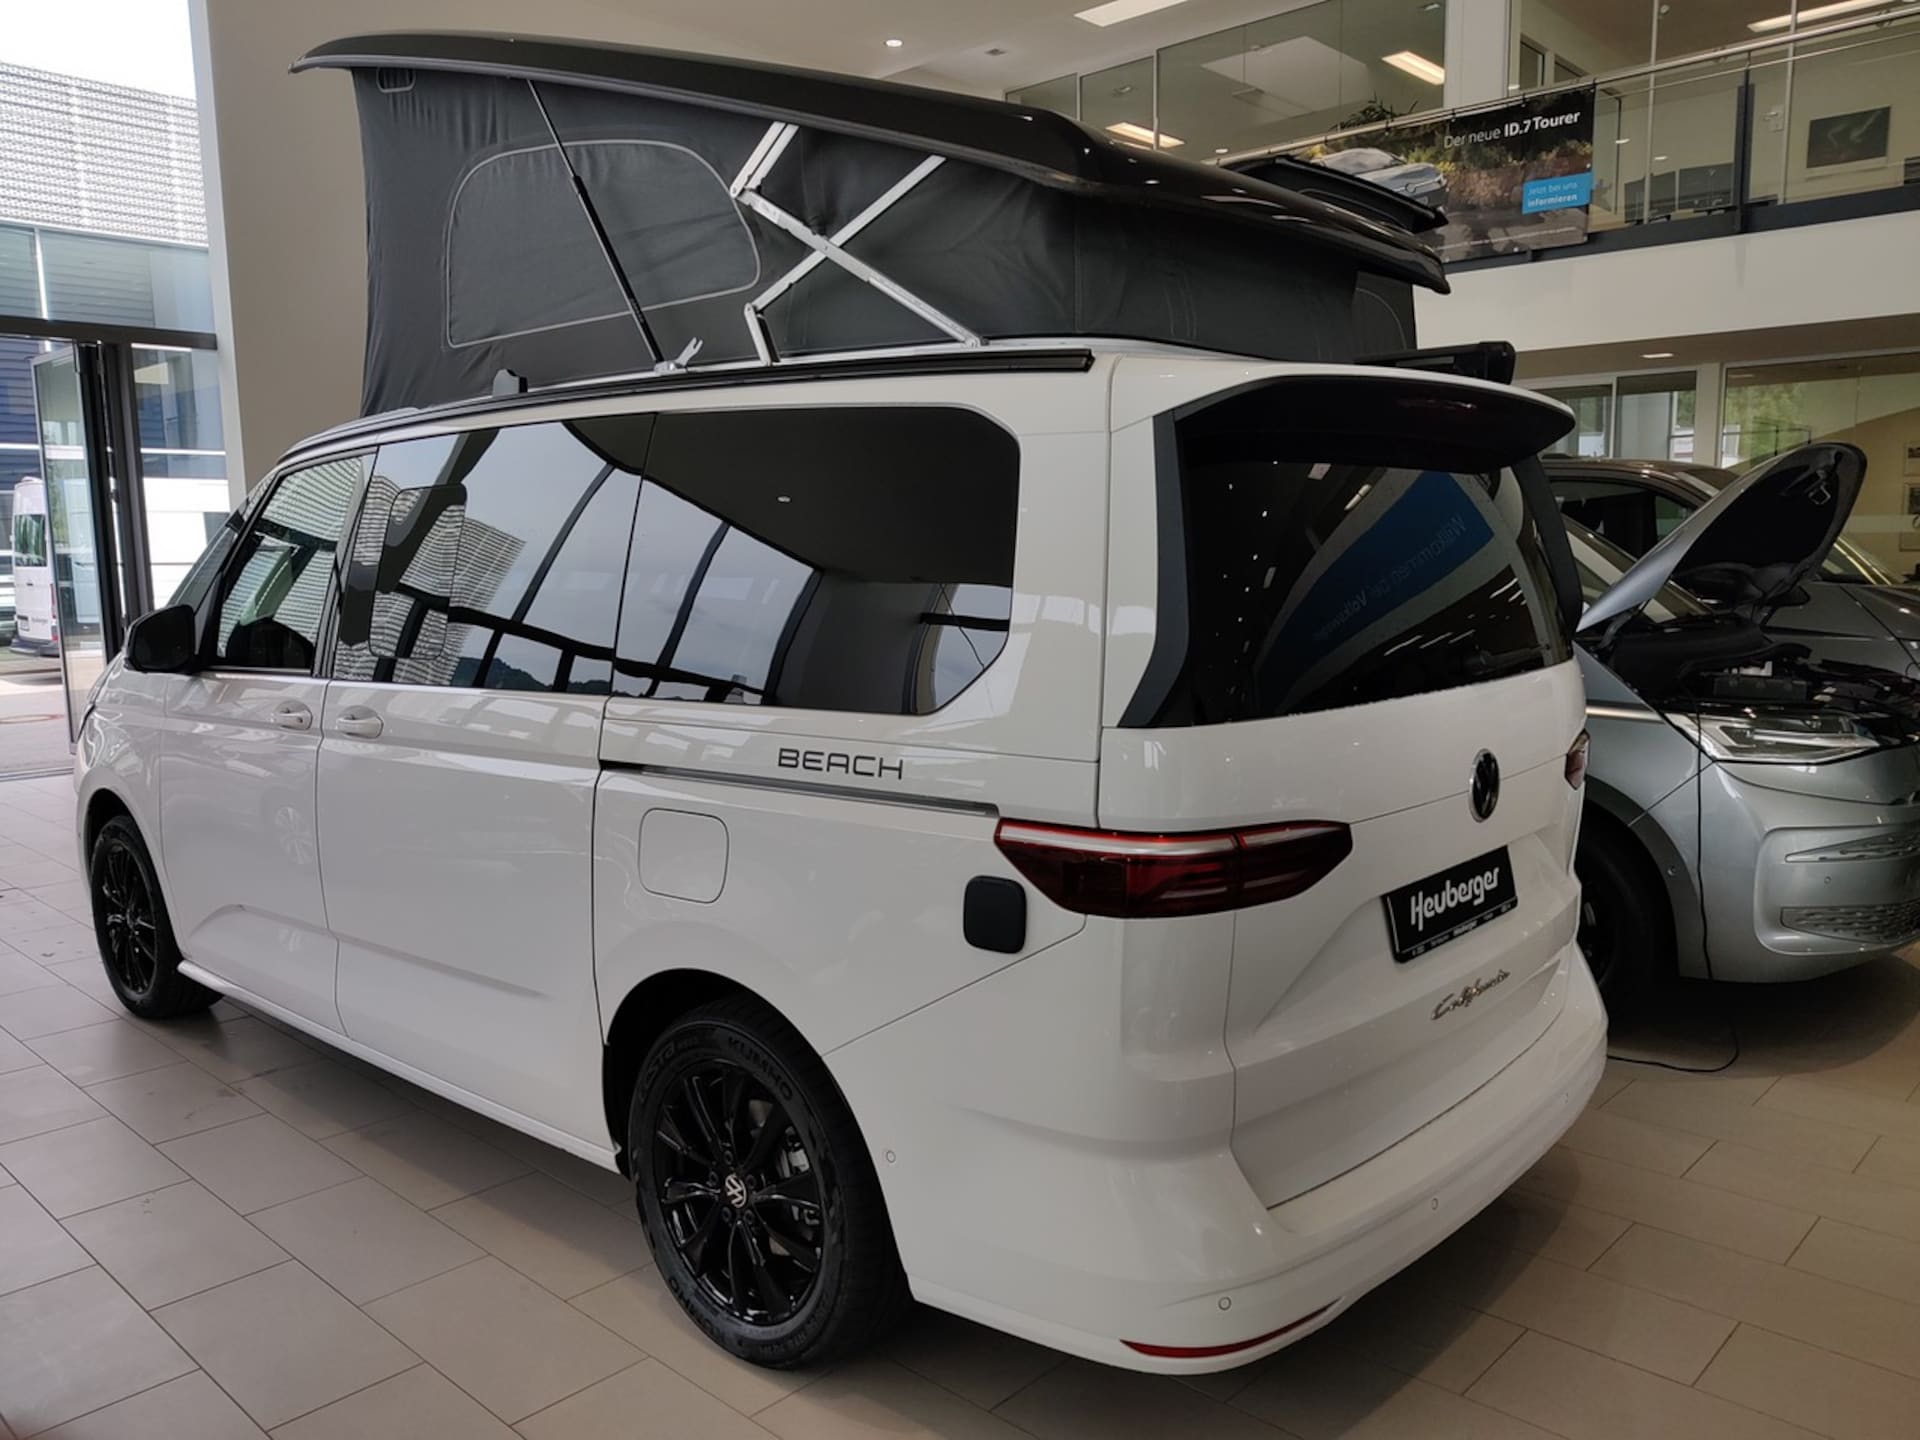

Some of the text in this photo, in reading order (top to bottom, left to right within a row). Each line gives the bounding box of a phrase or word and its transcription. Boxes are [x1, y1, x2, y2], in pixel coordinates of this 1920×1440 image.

[1443, 111, 1581, 149] Der neue ID.7 Tourer
[1527, 193, 1578, 208] informieren
[777, 747, 904, 780] BEACH
[1410, 867, 1500, 931] Heuberger
